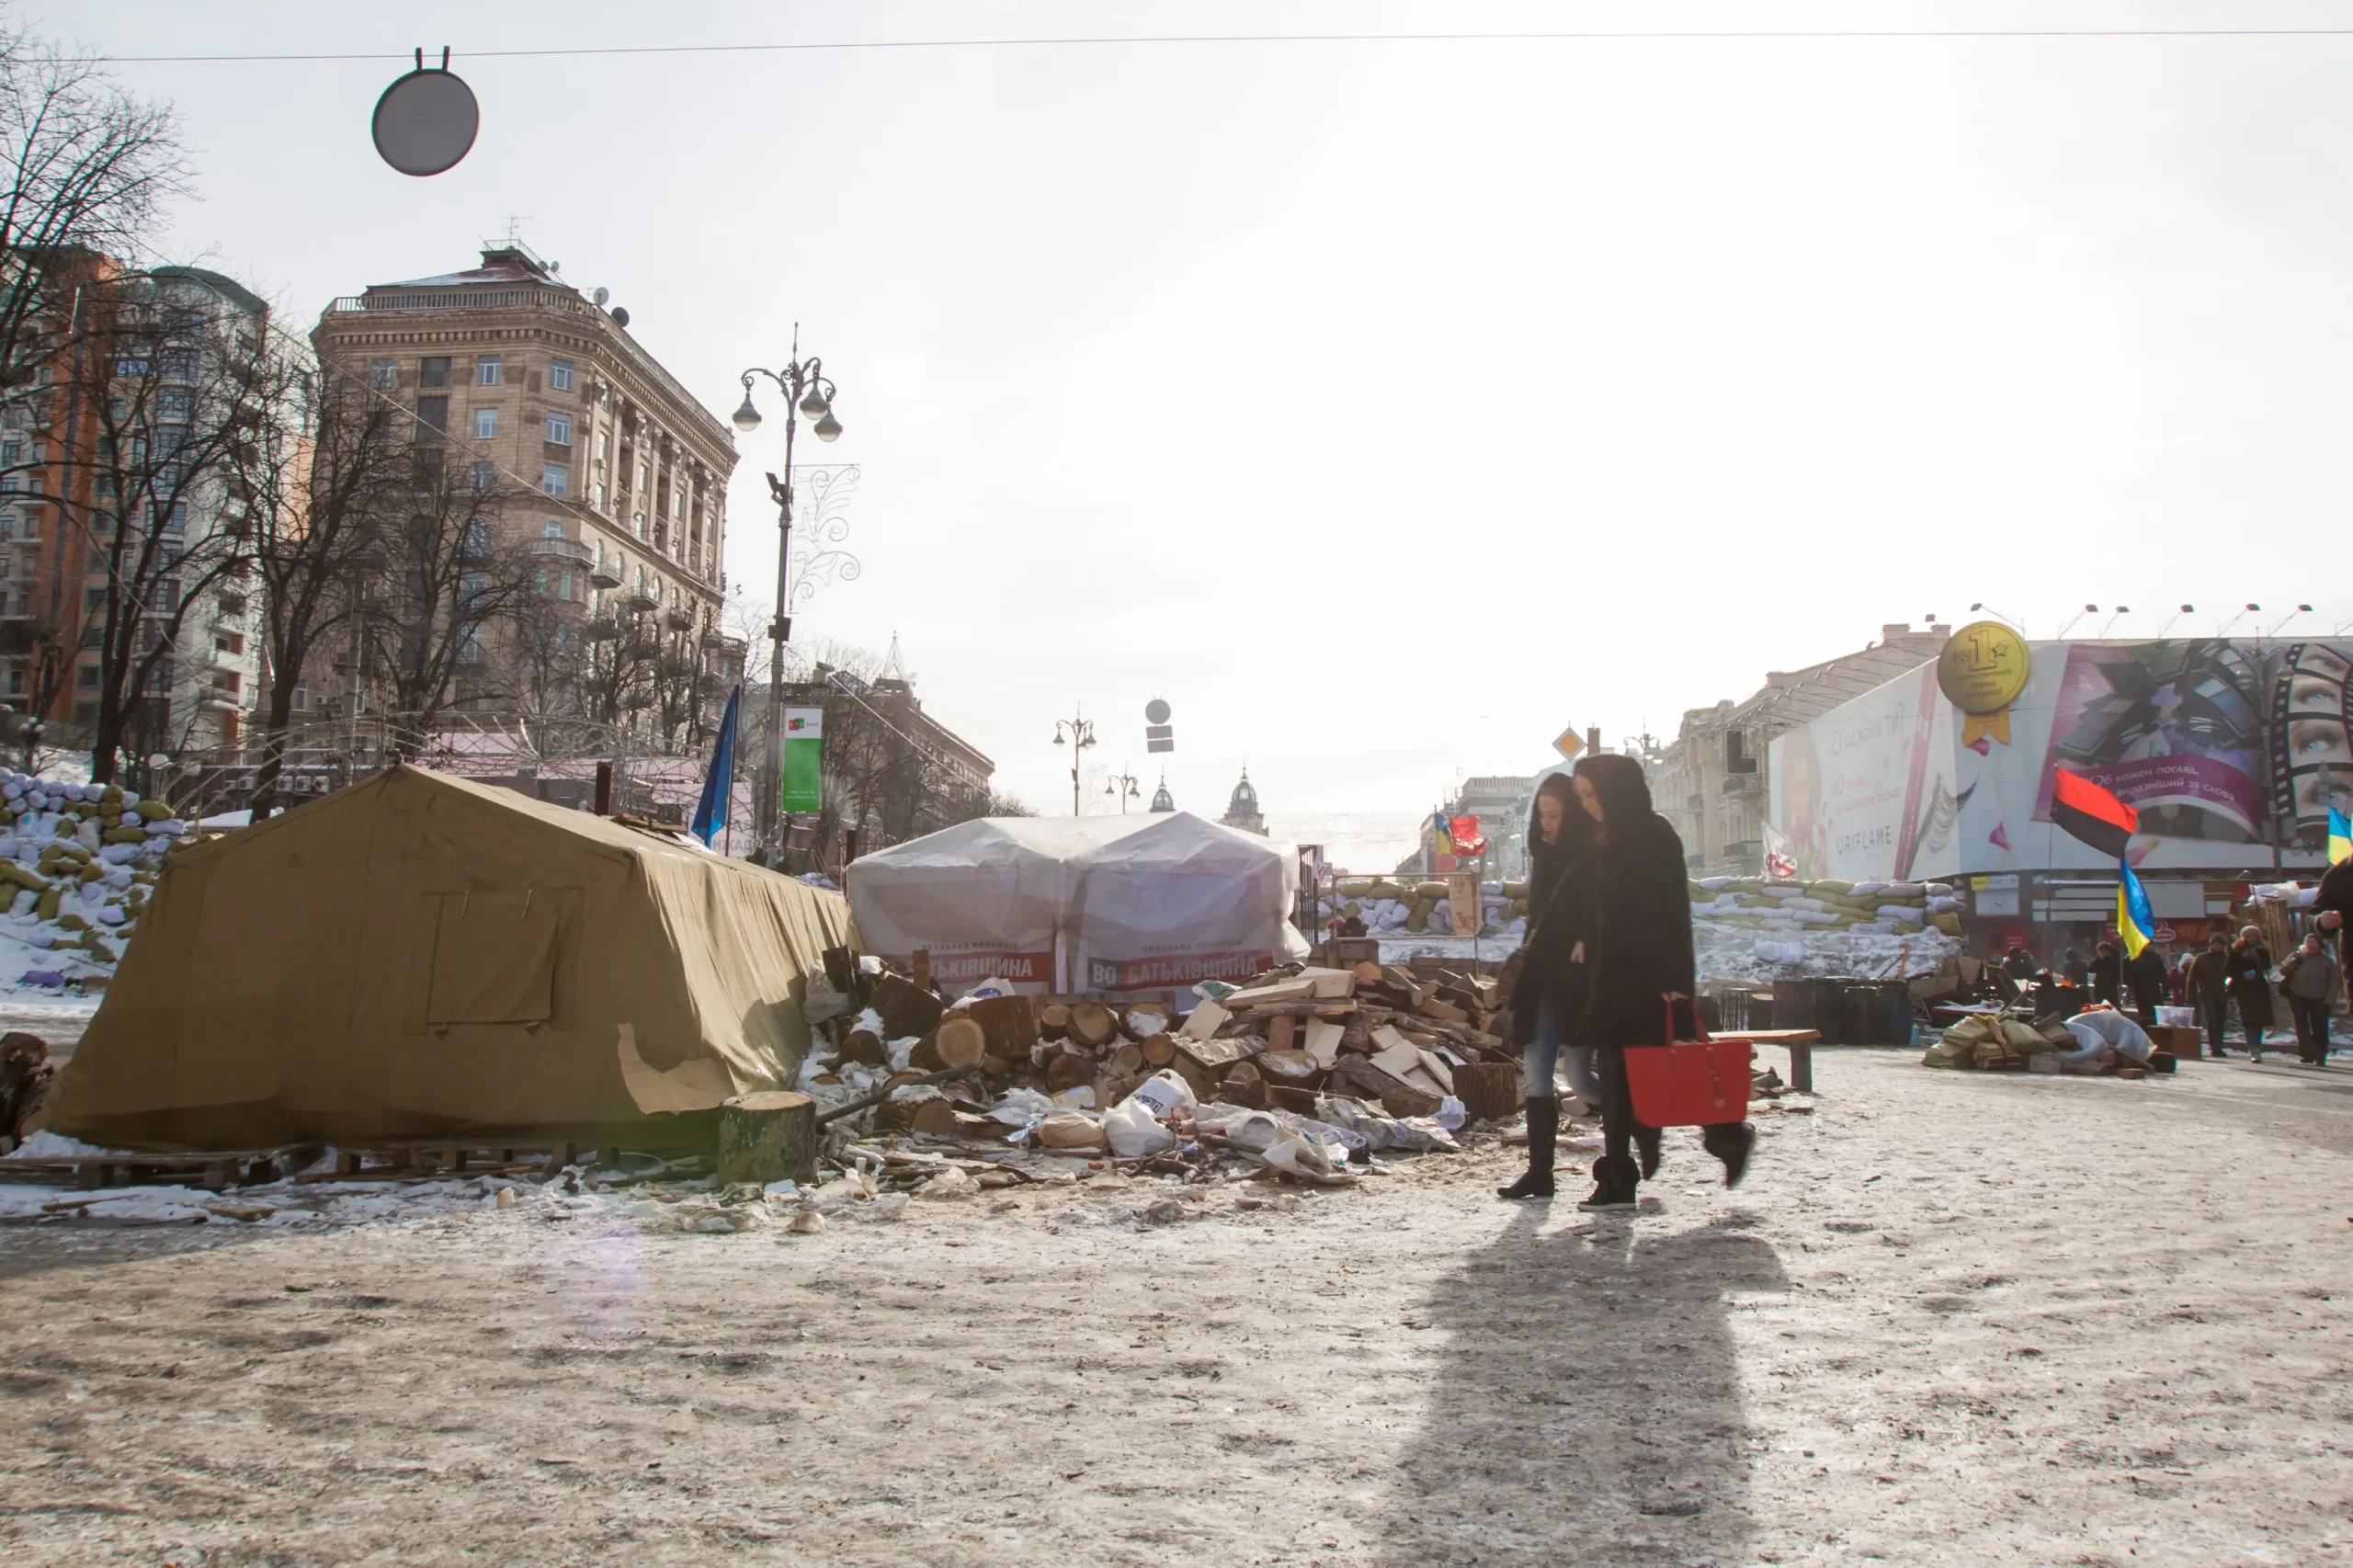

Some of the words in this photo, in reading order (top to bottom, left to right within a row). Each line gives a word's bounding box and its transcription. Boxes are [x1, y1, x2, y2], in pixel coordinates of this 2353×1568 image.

[2115, 768, 2153, 782] кожен
[2155, 766, 2200, 776] погляд,
[2116, 778, 2185, 798] виразніший
[2188, 780, 2200, 790] за
[2202, 783, 2235, 802] слова
[1836, 824, 1892, 855] ORIFLAME
[928, 957, 1033, 978] ТЬКІВЩИНА
[1092, 963, 1118, 985] ВО
[1127, 956, 1258, 984] БАТЬКІВЩИНА
